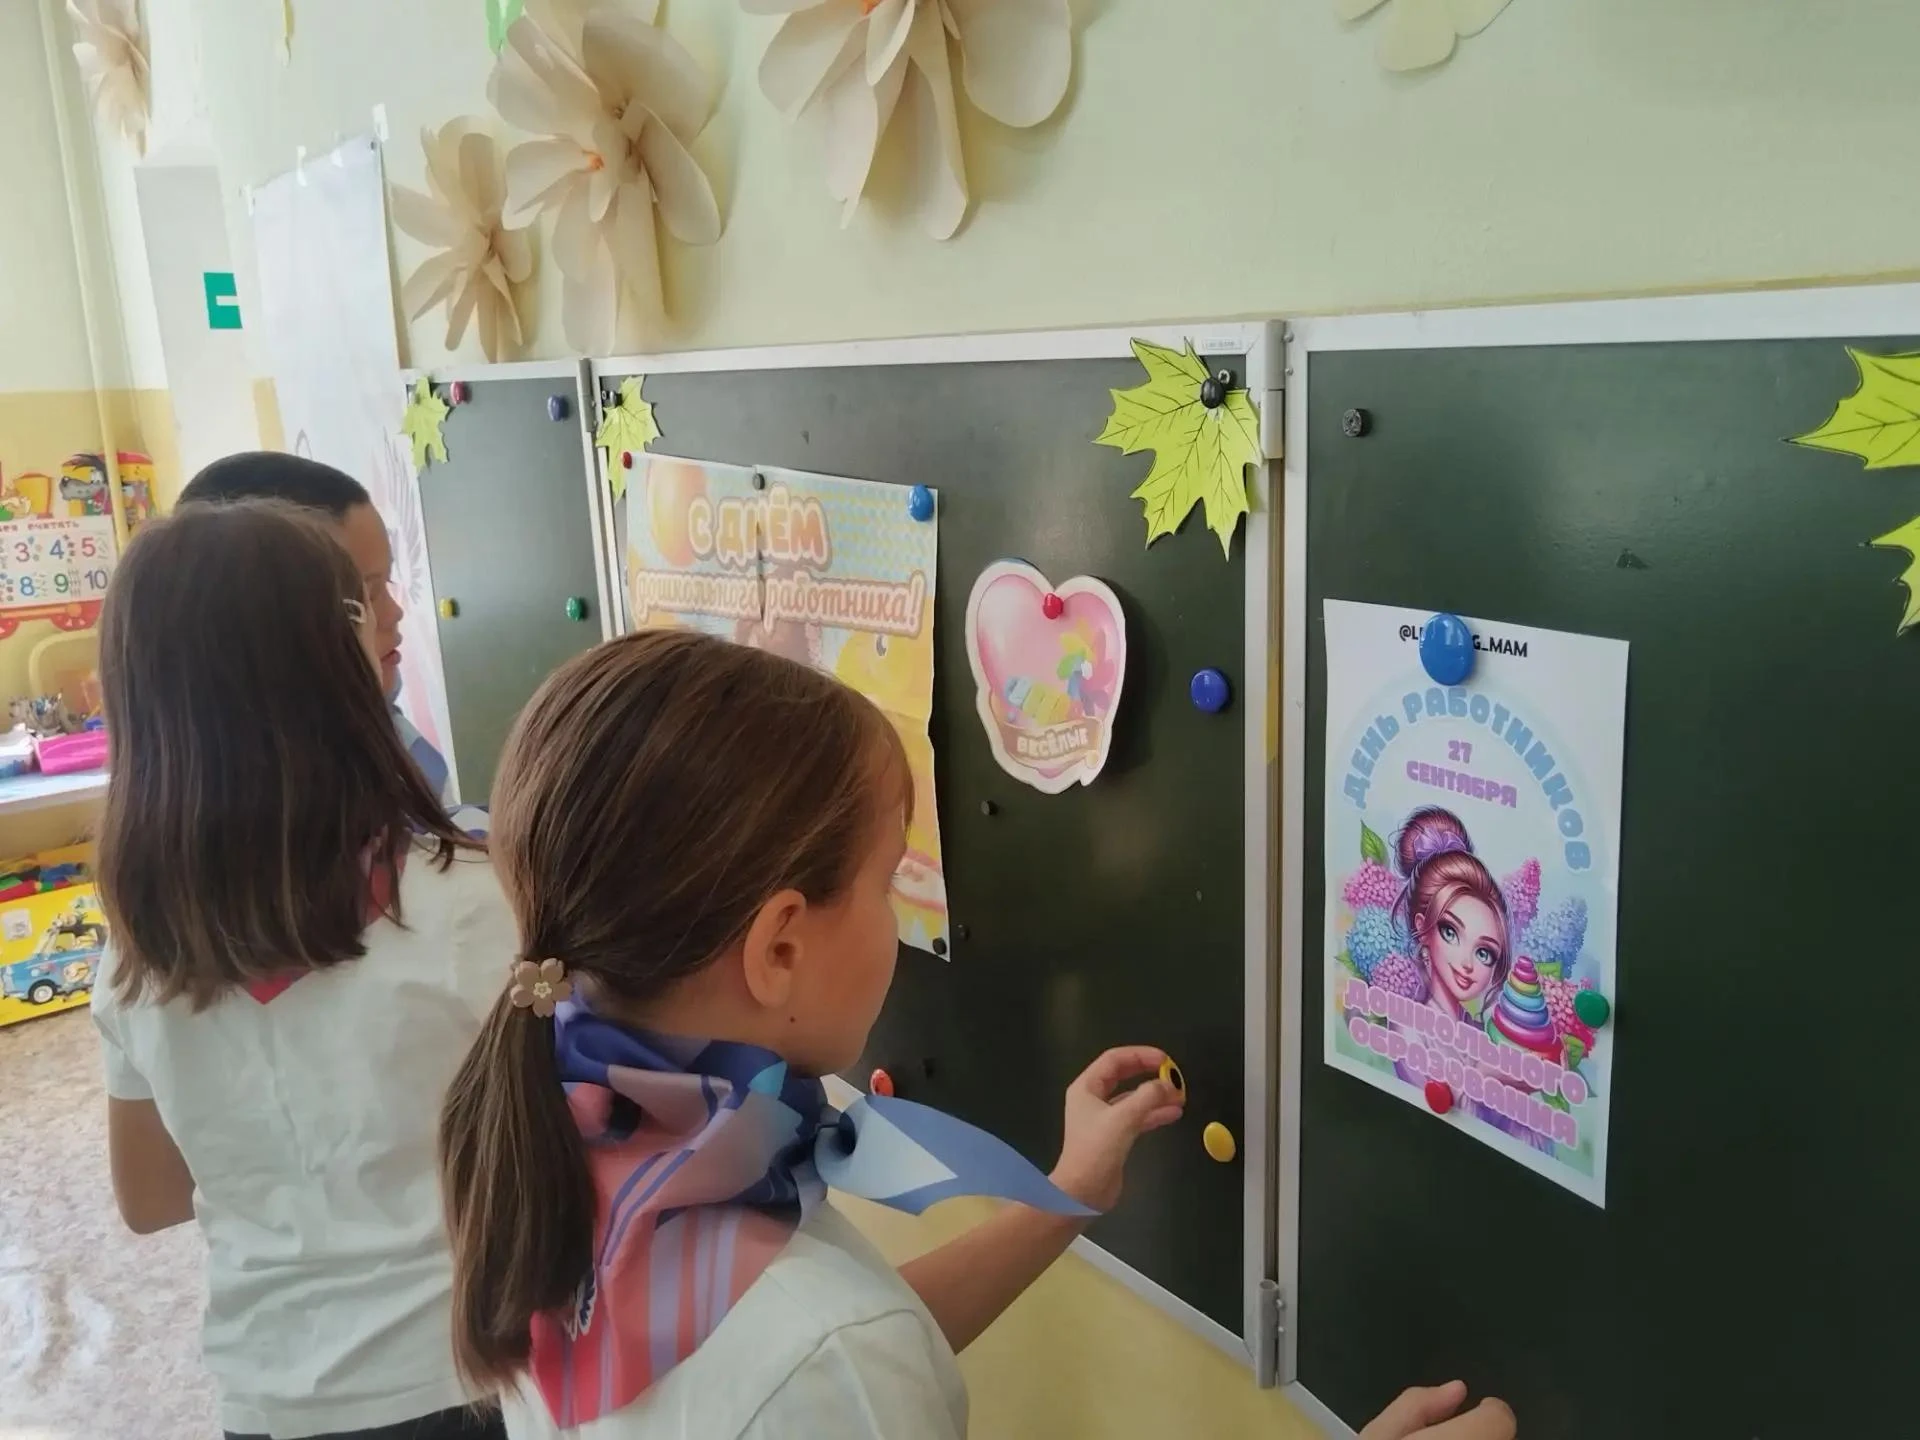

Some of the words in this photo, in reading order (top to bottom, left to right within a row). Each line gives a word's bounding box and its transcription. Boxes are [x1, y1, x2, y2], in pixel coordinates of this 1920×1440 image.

[14, 542, 30, 562] 3
[49, 539, 65, 560] 4
[81, 536, 96, 557] 5
[688, 501, 713, 554] С
[20, 576, 35, 596] 8
[54, 573, 69, 594] 9
[84, 570, 108, 590] 10
[763, 572, 925, 634] работника!
[1448, 740, 1473, 764] 27
[1343, 714, 1400, 809] ДЕНЬ
[1402, 687, 1591, 871] РАБОТНИКОВ
[1406, 760, 1518, 809] СЕНТЯБРЯ
[1344, 977, 1588, 1107] ДОШКОЛЬНОГО
[1349, 1016, 1578, 1148] ОБРАЗОВАНИЯ
